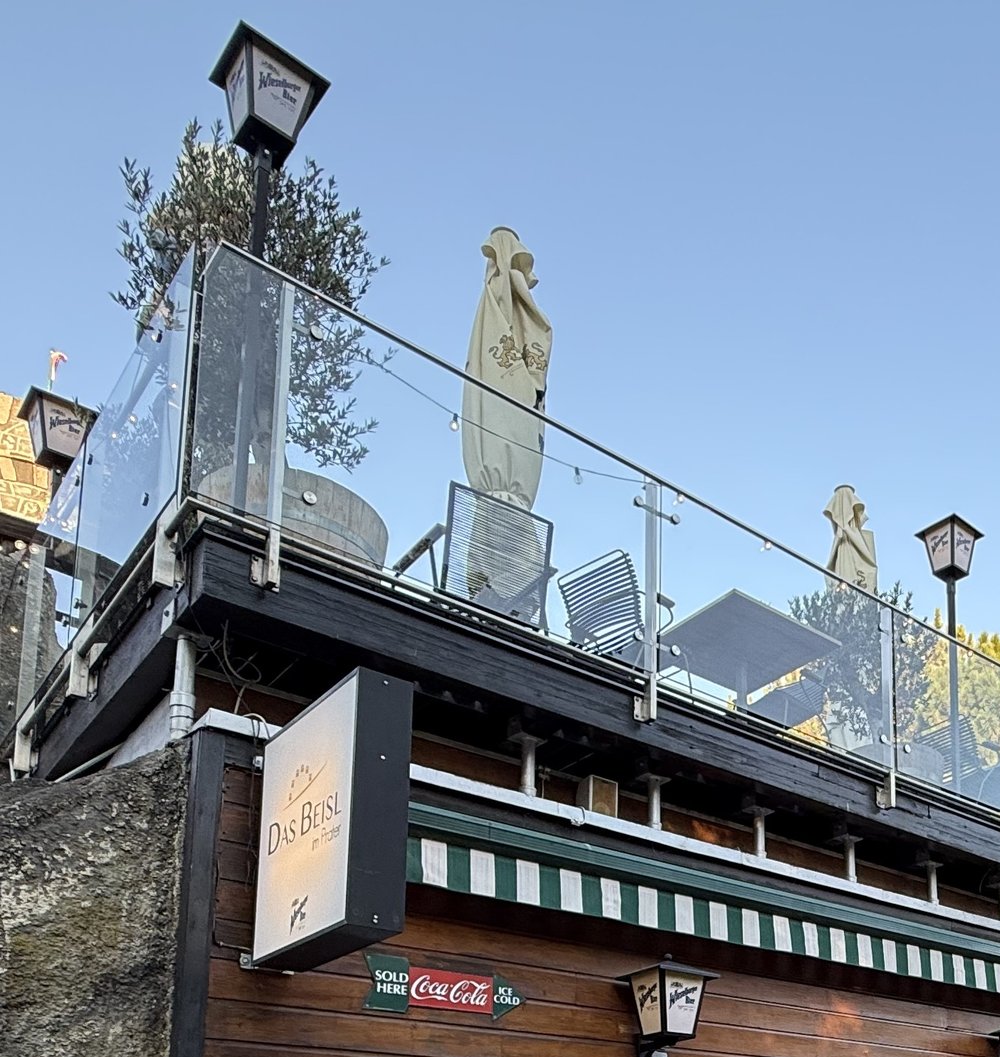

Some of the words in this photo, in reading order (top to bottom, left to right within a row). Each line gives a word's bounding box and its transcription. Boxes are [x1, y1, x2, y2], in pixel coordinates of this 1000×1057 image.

[268, 819, 296, 856] DAS
[300, 791, 342, 837] BEISL
[320, 823, 342, 845] Prater
[375, 969, 409, 983] SOLD
[376, 982, 408, 996] HERE
[410, 974, 491, 1006] Coca-Cola
[498, 986, 513, 996] ICE
[493, 994, 520, 1006] COLD
